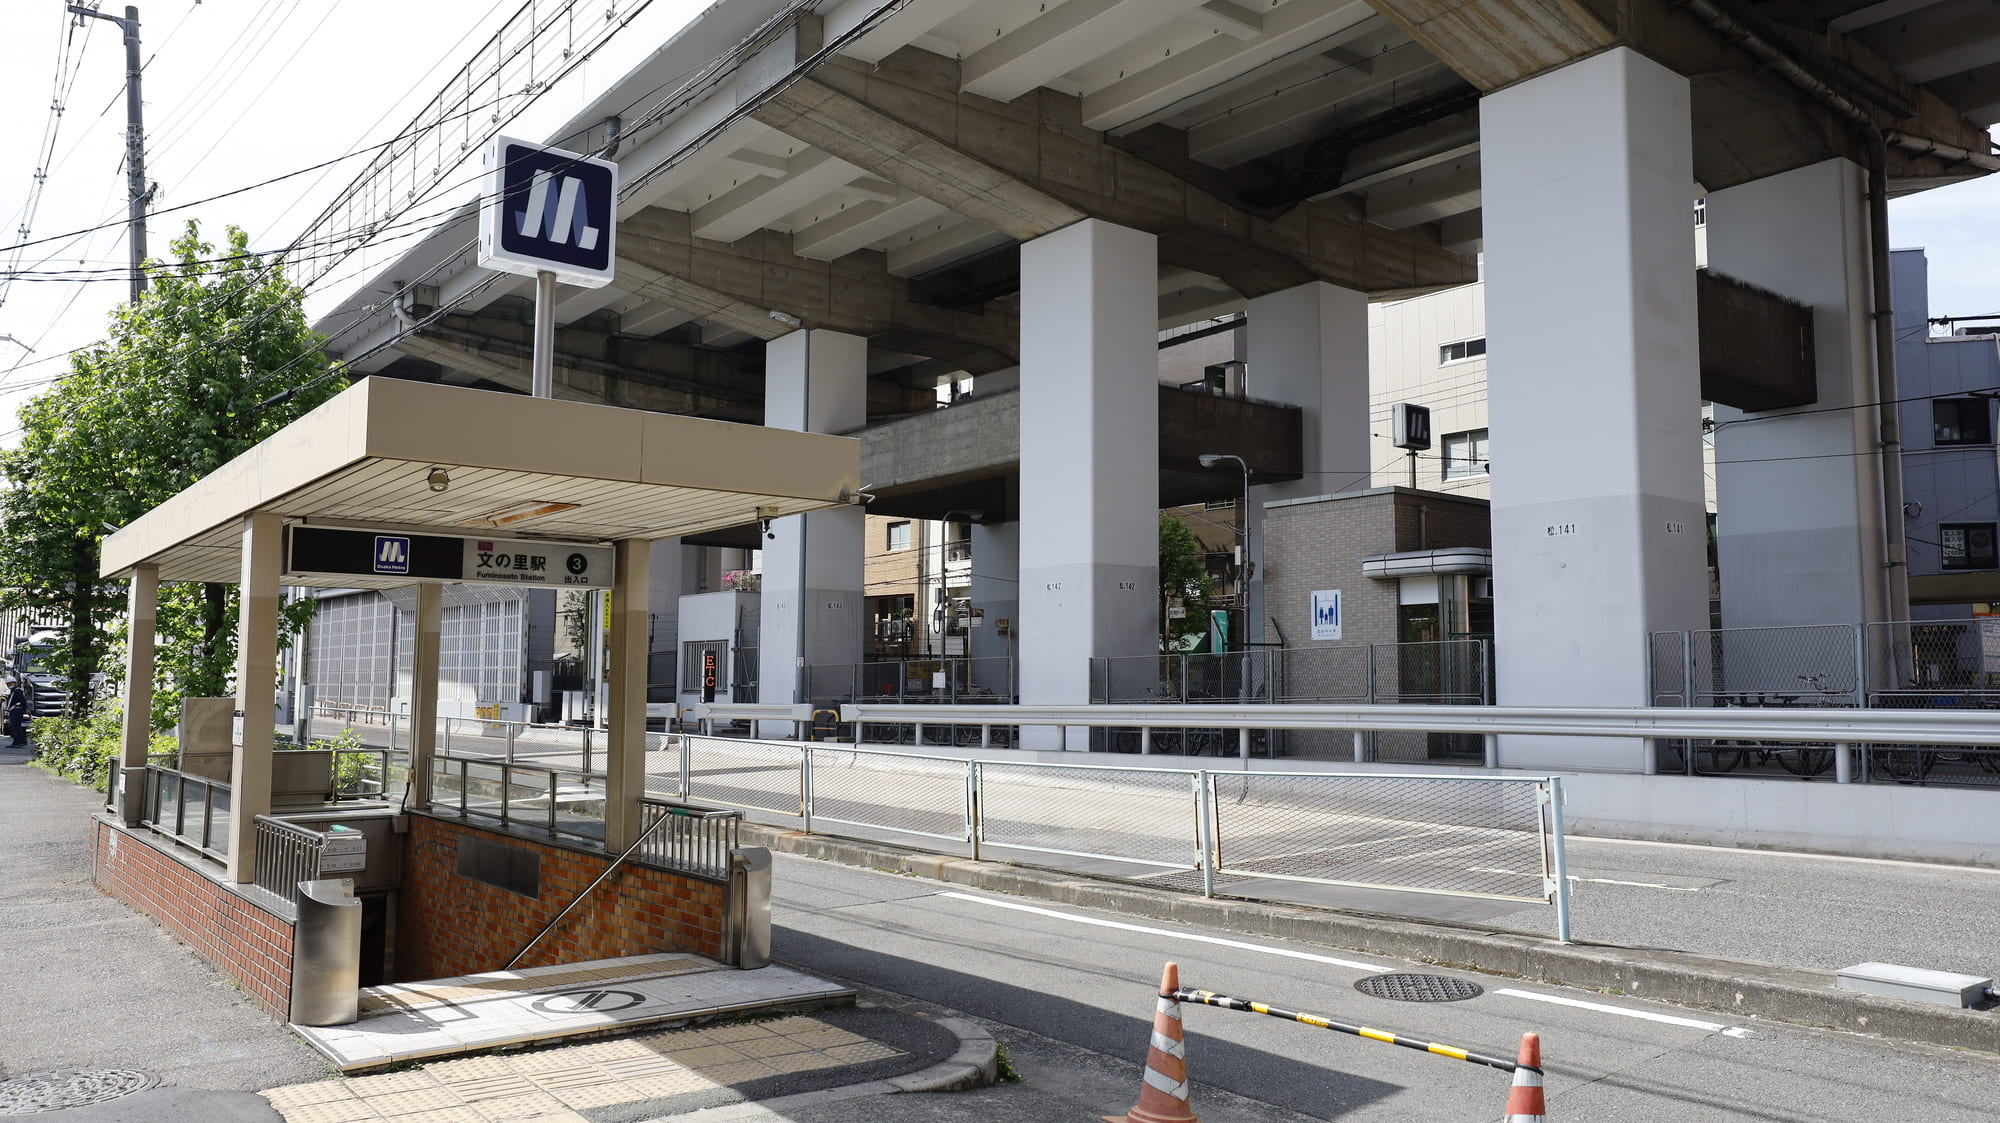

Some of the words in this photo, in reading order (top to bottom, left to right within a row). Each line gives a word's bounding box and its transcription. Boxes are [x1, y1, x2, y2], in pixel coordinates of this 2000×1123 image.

[477, 552, 546, 571] 文の里駅
[476, 571, 518, 580] Fuminosato
[564, 575, 589, 584] 出入口
[705, 655, 716, 687] ETC
